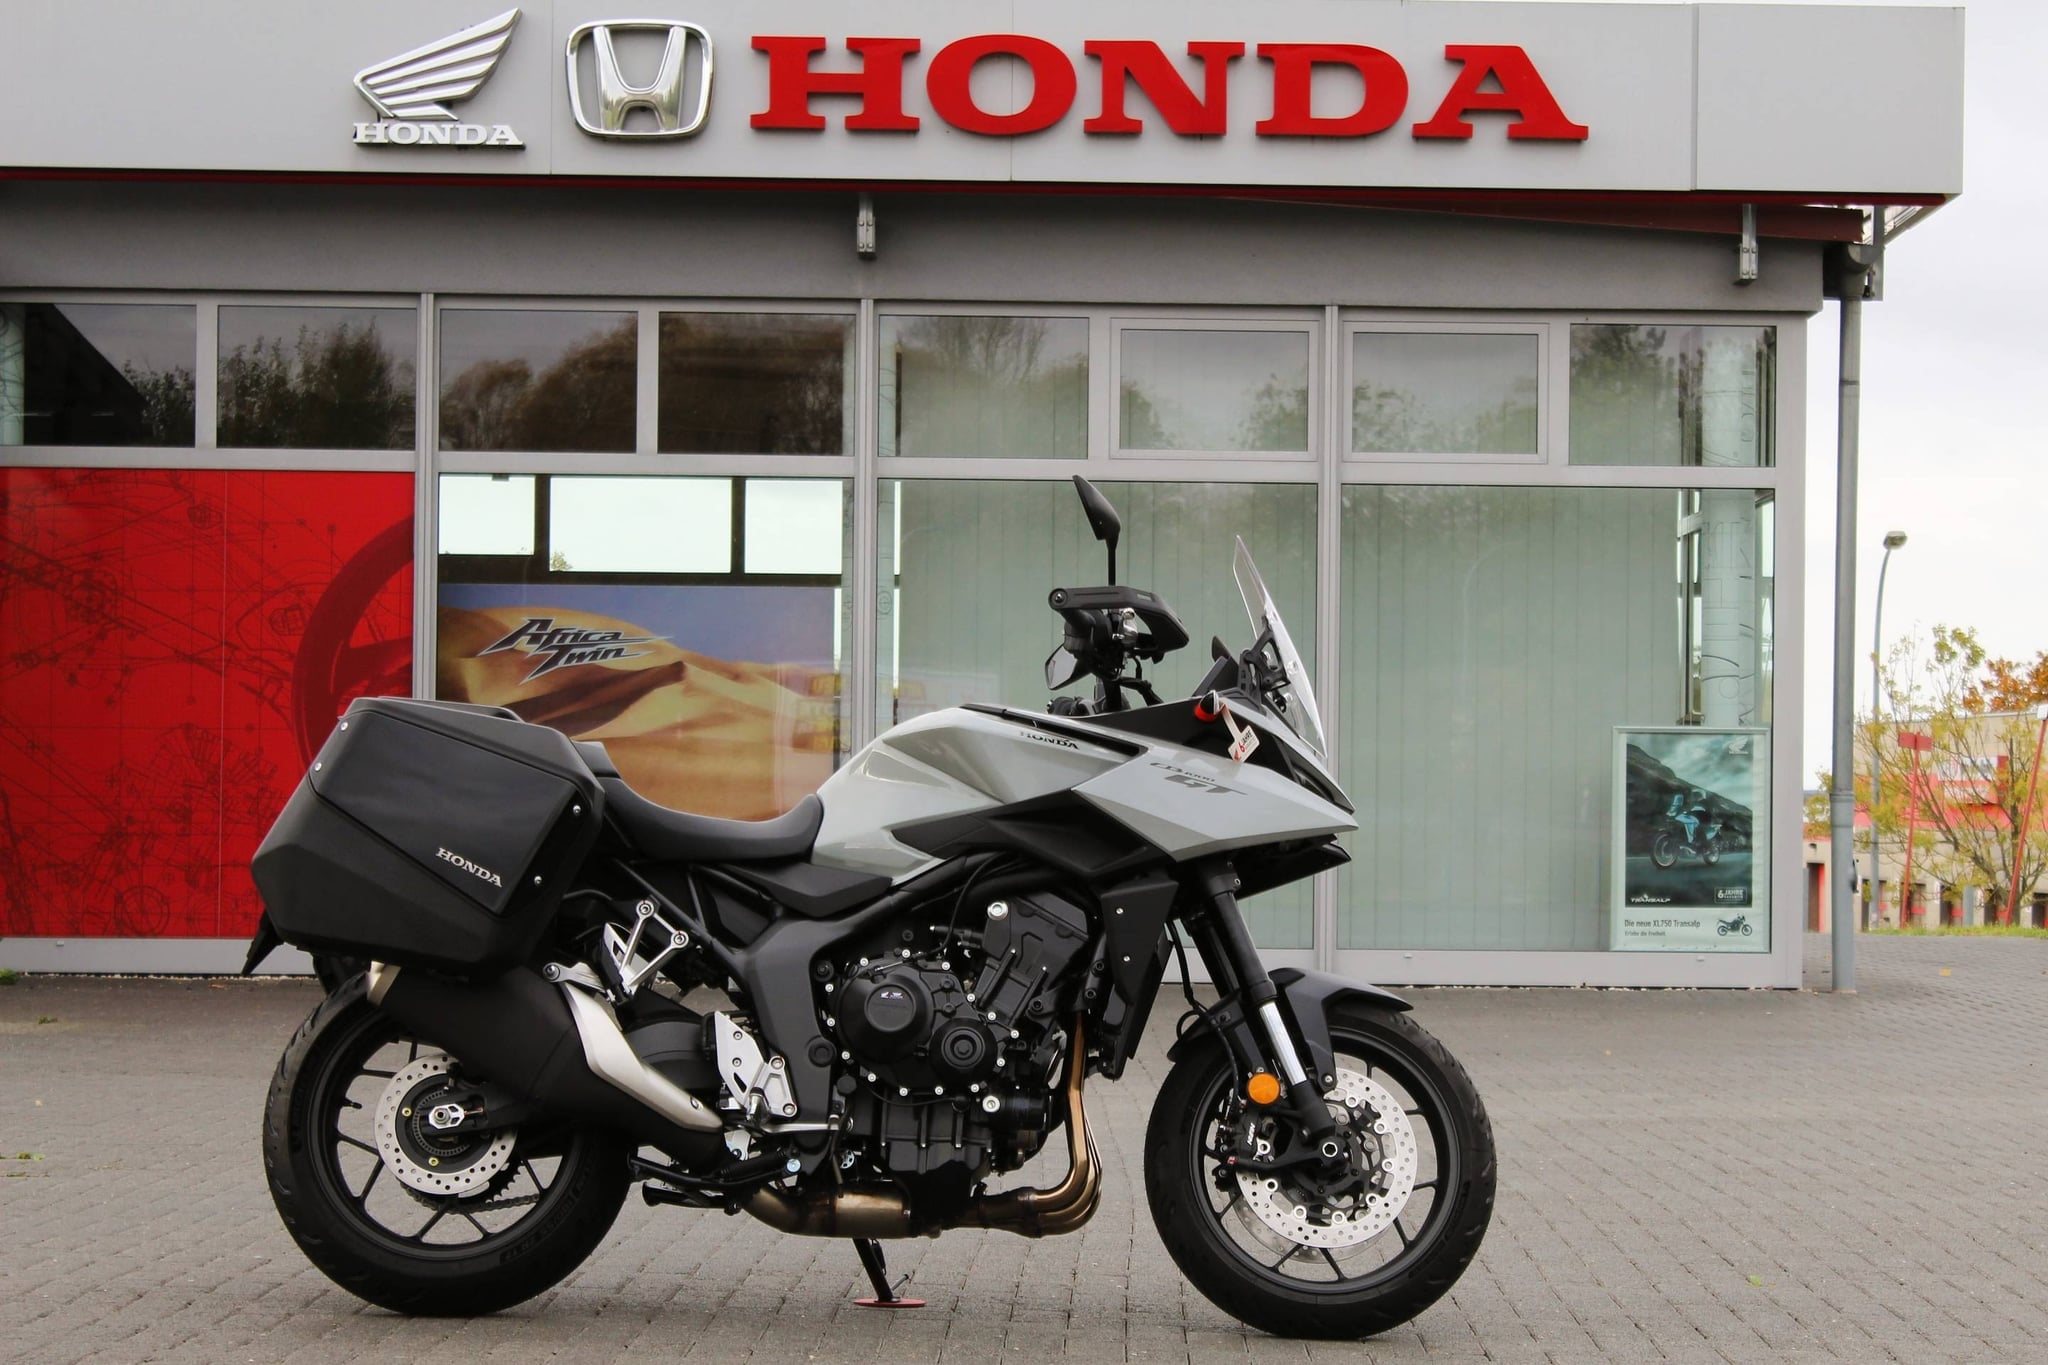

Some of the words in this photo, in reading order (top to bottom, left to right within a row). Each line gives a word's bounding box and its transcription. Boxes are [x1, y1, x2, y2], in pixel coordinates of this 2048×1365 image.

[750, 34, 1588, 142] HONDA
[352, 122, 524, 146] HONDA
[476, 617, 673, 658] Africa
[519, 645, 656, 685] Twin
[1163, 774, 1249, 794] GT
[435, 847, 503, 888] HONDA
[1717, 889, 1724, 899] 6
[1624, 919, 1635, 928] Die
[1635, 920, 1652, 928] neue
[1673, 919, 1701, 930] Transalp
